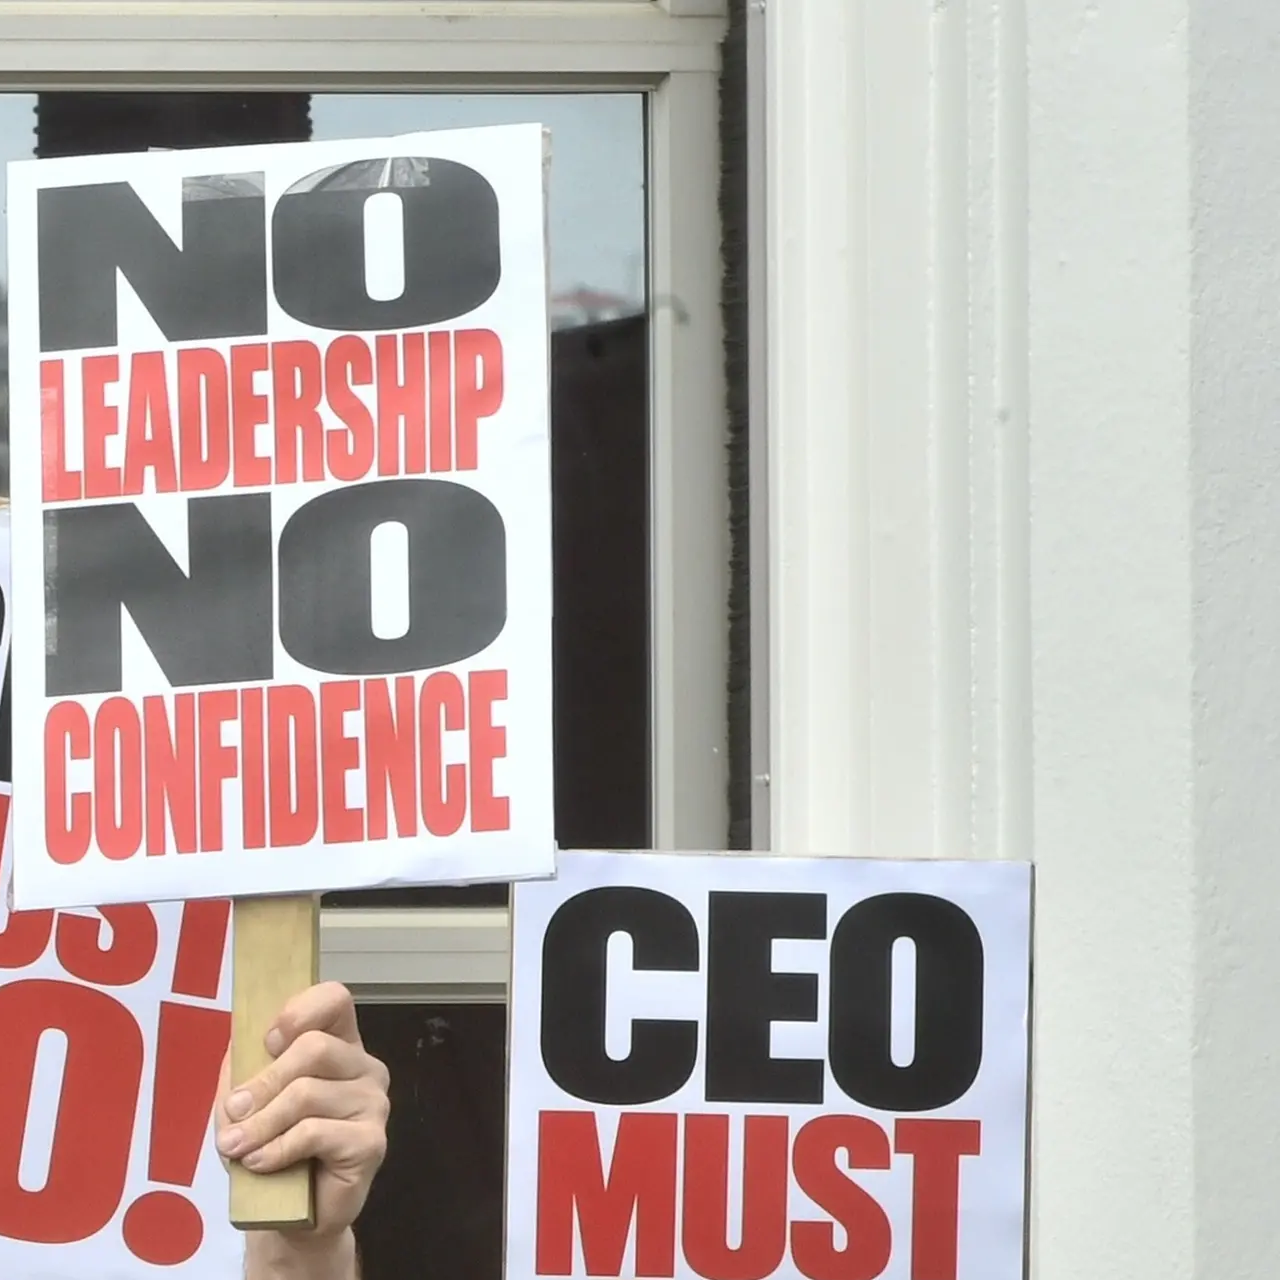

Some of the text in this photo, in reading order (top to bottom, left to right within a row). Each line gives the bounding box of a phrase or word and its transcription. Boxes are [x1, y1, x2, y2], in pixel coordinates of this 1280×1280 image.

[37, 156, 501, 352] NO
[40, 329, 504, 503] LEADERSHIP
[42, 479, 507, 697] NO
[44, 670, 511, 865] CONFIDENCE
[540, 885, 985, 1113] CEO
